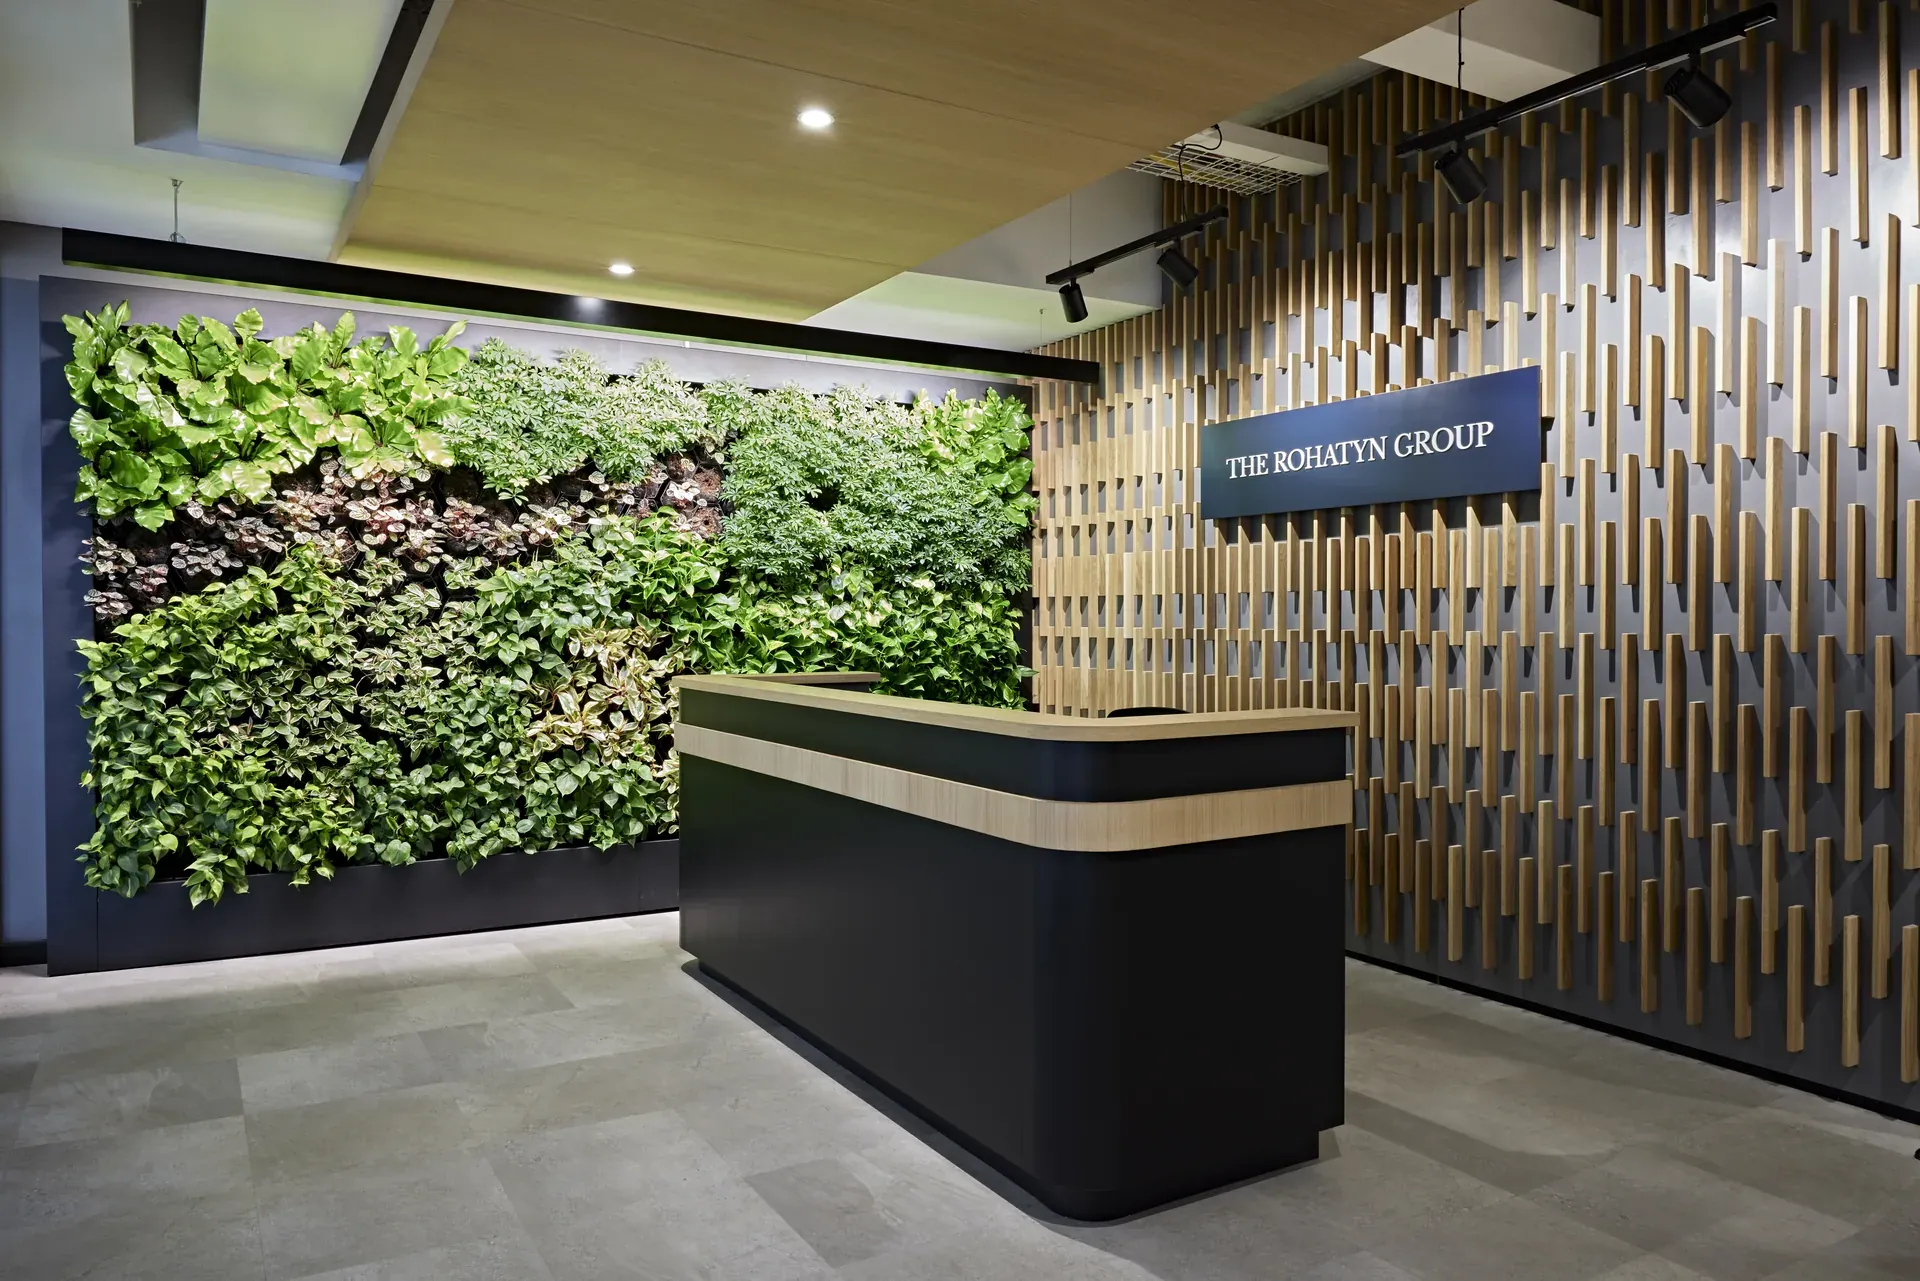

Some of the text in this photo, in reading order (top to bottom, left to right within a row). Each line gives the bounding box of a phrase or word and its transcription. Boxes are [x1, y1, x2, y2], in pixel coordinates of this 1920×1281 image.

[1225, 421, 1494, 479] THE ROHATYN GROUP
